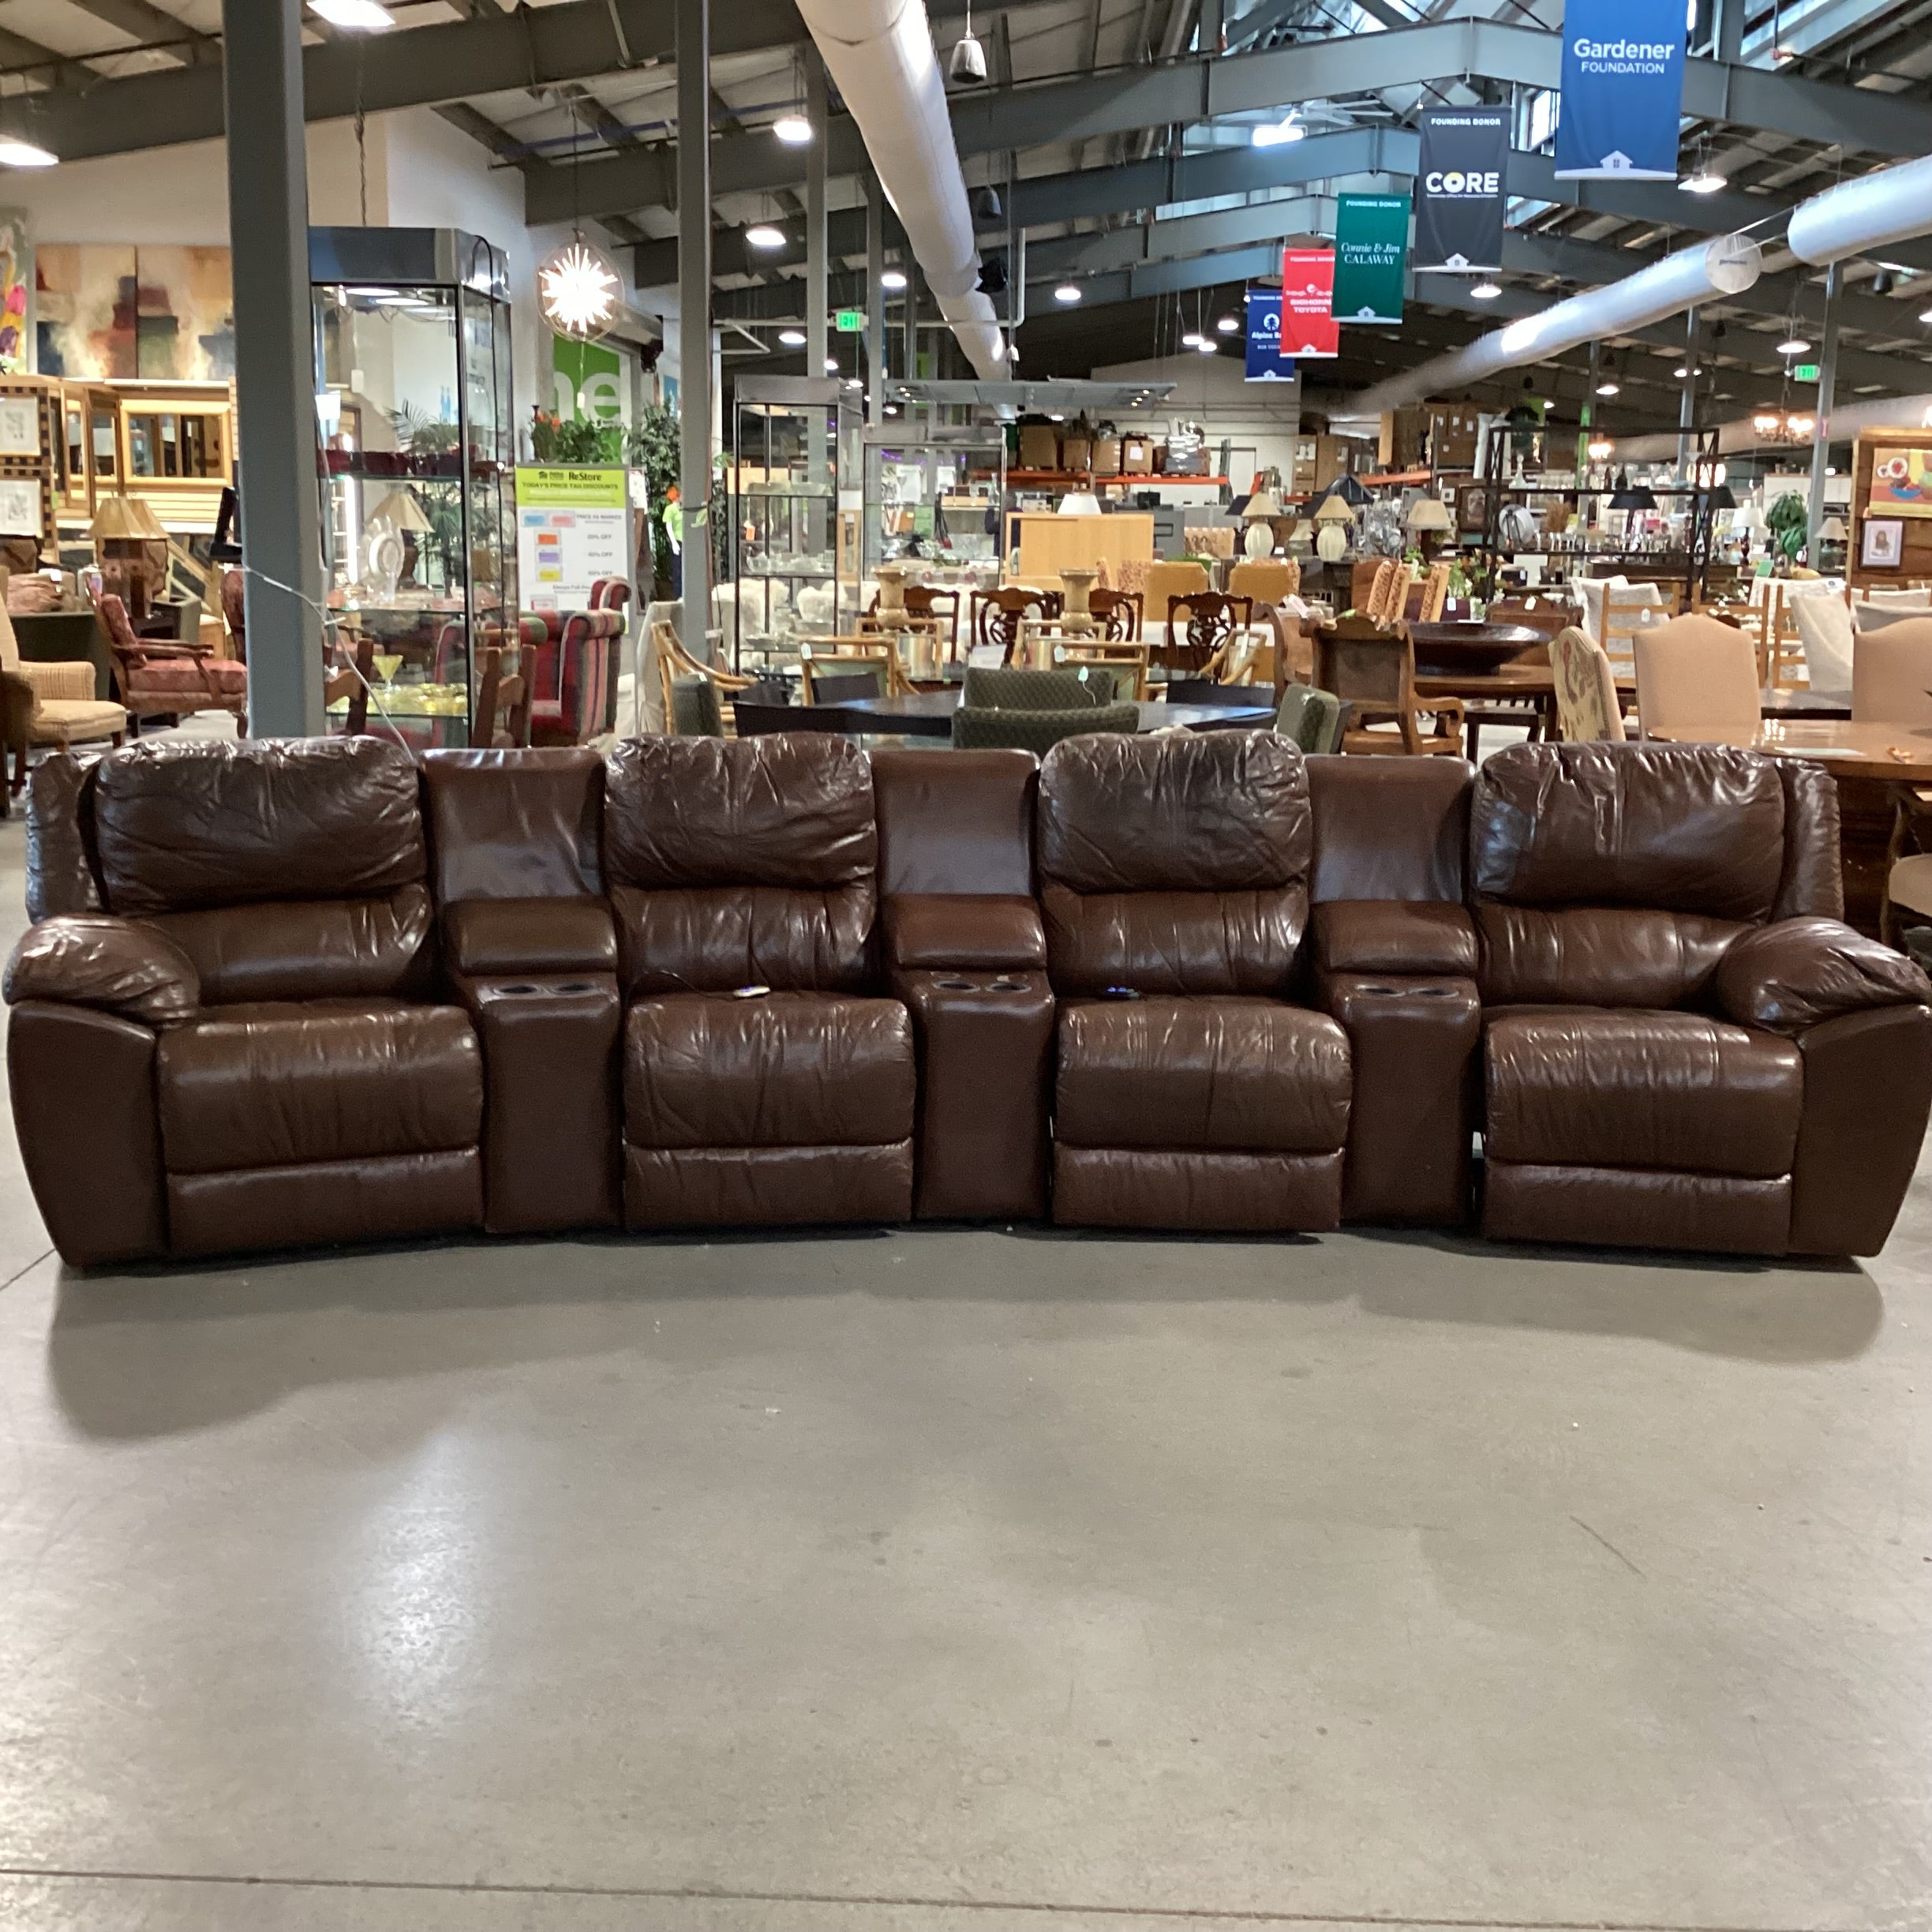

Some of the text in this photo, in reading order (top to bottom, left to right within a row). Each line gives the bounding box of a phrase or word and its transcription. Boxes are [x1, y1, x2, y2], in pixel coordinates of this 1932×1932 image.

[1574, 38, 1675, 60] Gardener
[1581, 62, 1664, 74] FOUNDATION
[1473, 118, 1501, 126] DONOR
[1425, 171, 1500, 193] CORE
[1341, 242, 1400, 254] Connie & Jim
[1344, 254, 1395, 265] CALAWAY
[568, 471, 602, 481] ReStore
